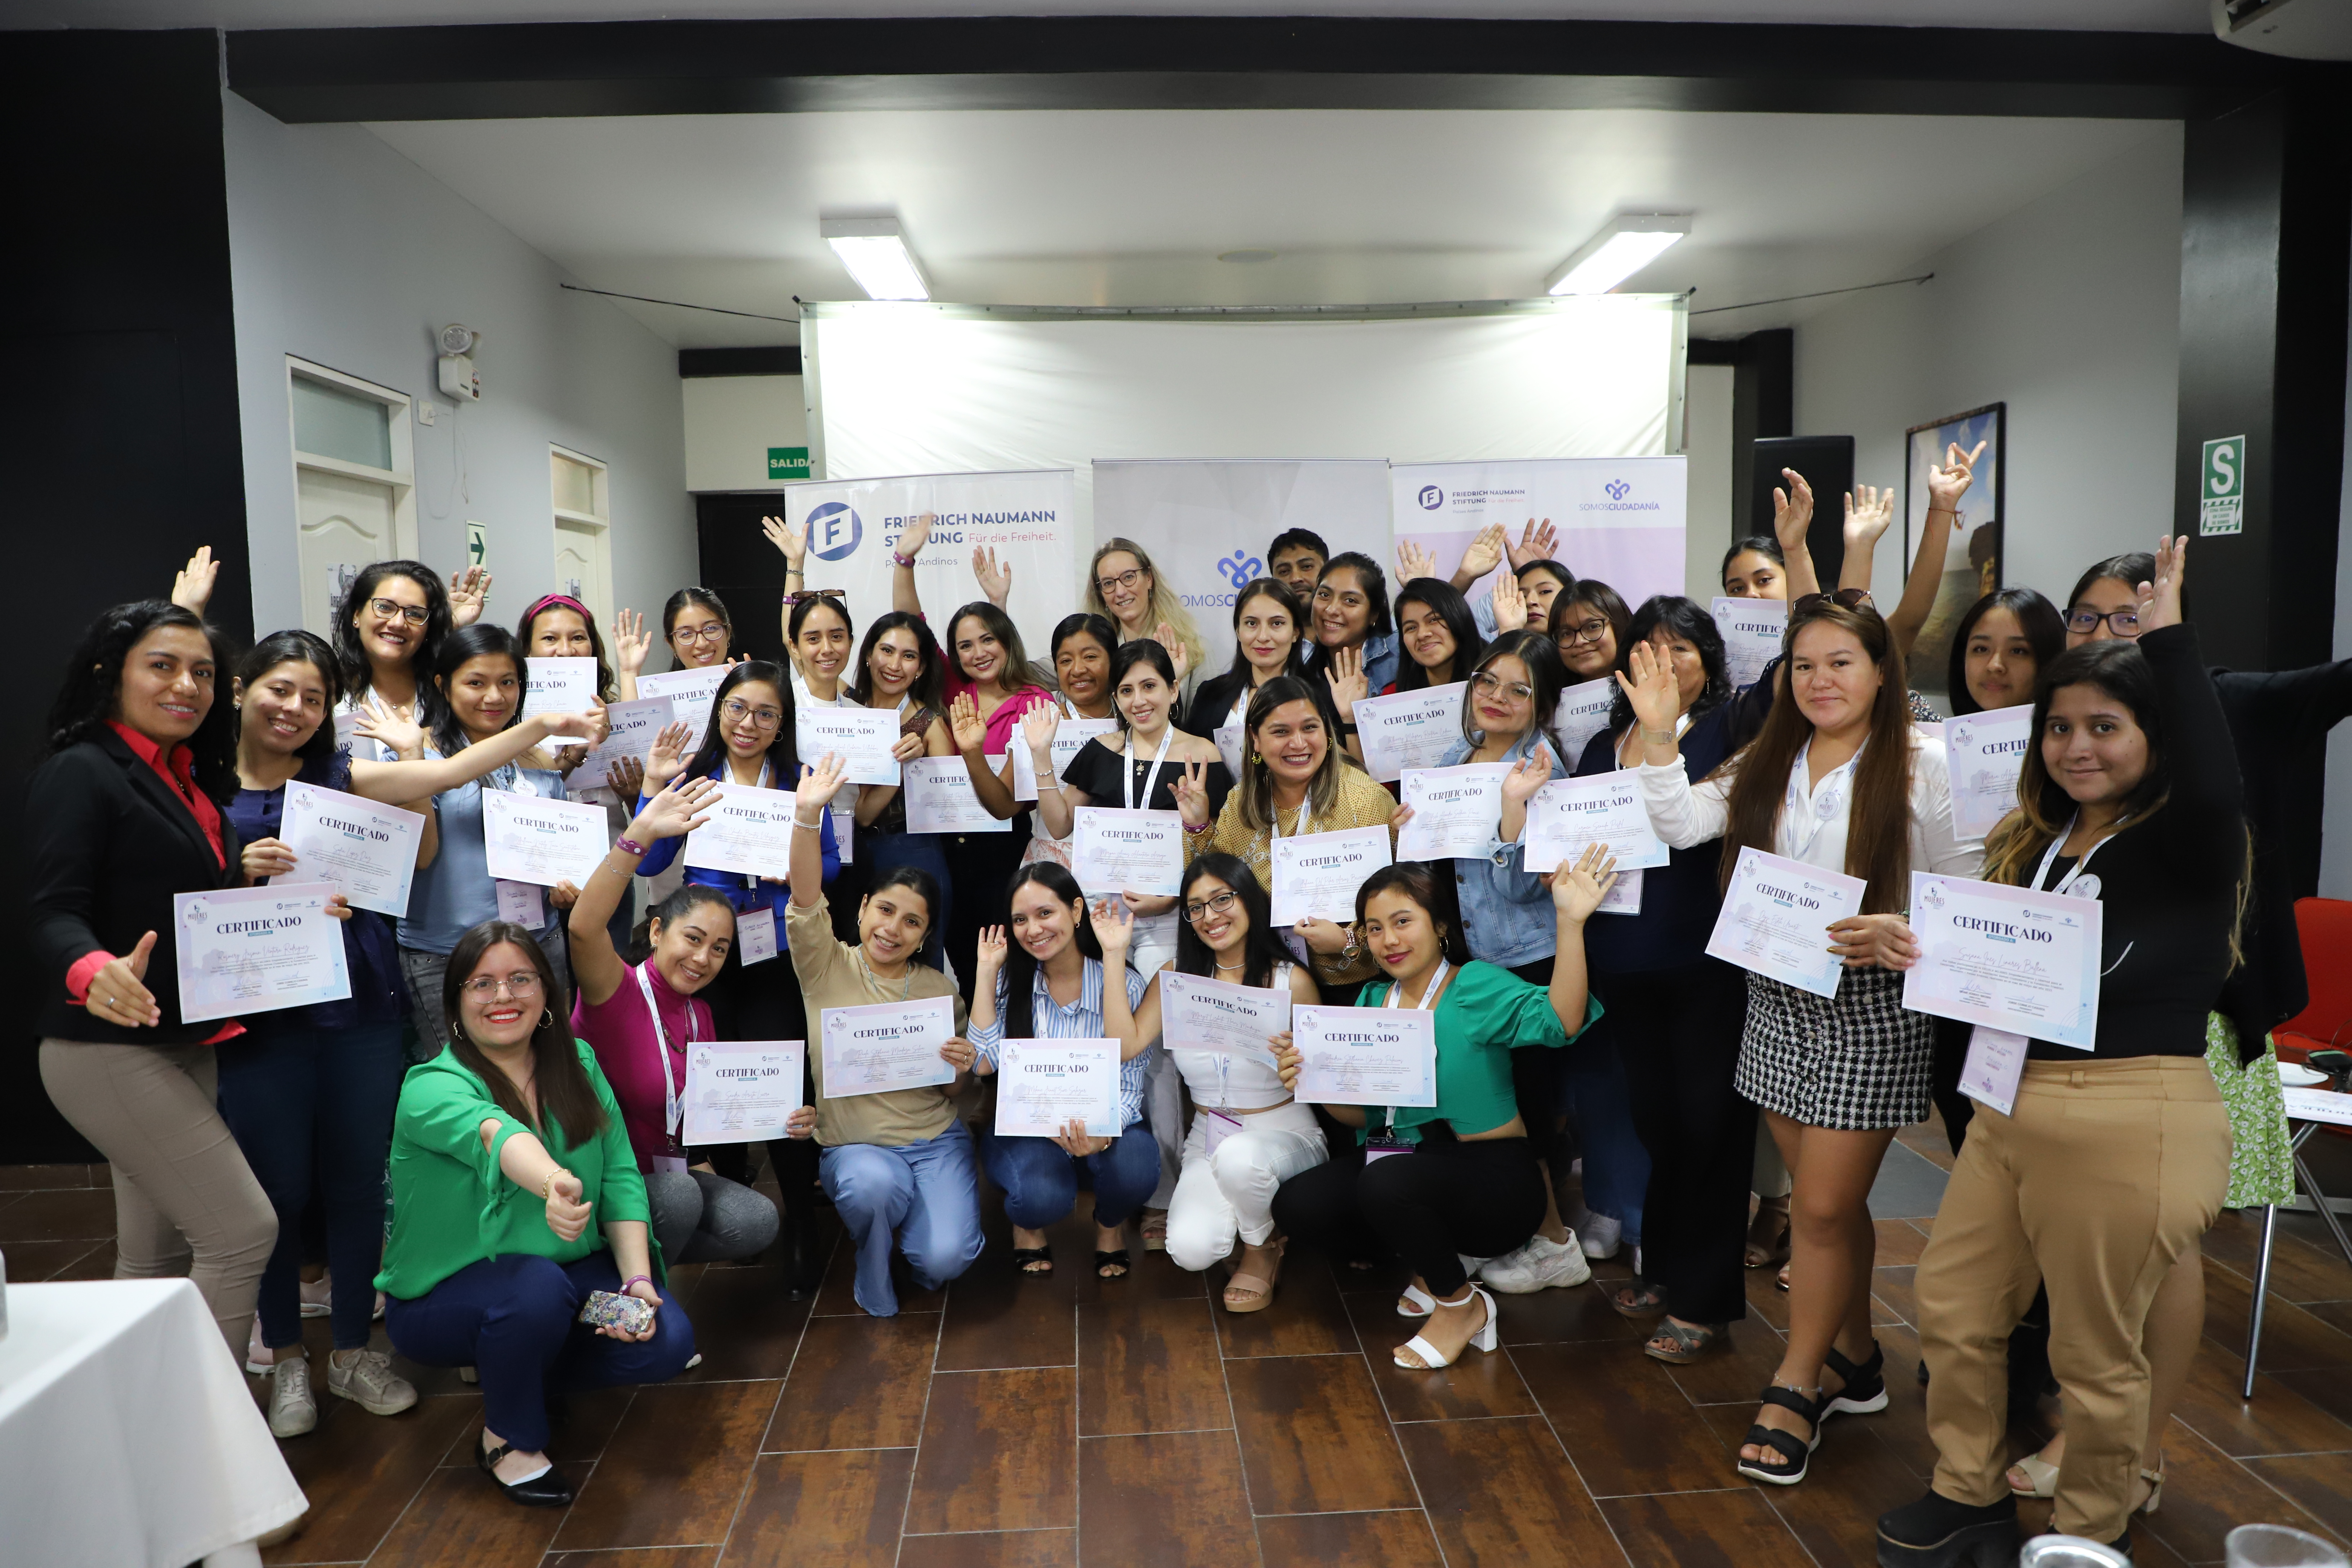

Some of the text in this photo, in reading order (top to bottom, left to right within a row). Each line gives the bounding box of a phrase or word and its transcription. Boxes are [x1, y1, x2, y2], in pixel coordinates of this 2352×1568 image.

[2211, 444, 2235, 495] S
[1579, 501, 1660, 511] SOMOSCIUDADANÍA
[972, 510, 1055, 524] NAUMANN
[969, 533, 987, 542] Für
[991, 533, 1008, 542] die
[1011, 531, 1056, 542] Freiheit.
[918, 557, 958, 567] Andinos
[1383, 708, 1446, 726] CERTIFICADO
[1955, 734, 1973, 744] MUJERES
[1429, 787, 1482, 800] CERTIFICADO
[296, 798, 313, 809] MUJERES
[1561, 796, 1632, 812] CERTIFICADO
[723, 806, 790, 823] CERTIFICADO
[319, 815, 389, 842] CERTIFICADO
[513, 816, 579, 833] CERTIFICADO
[1102, 830, 1163, 840] CERTIFICADO
[1300, 853, 1362, 867] CERTIFICADO
[1743, 865, 1756, 875] MUJERES
[1755, 882, 1820, 911] CERTIFICADO
[1924, 895, 1944, 906] MUJERES
[188, 912, 207, 921] MUJERES
[216, 916, 302, 934] CERTIFICADO
[1953, 914, 2052, 944] CERTIFICADO
[1958, 946, 1981, 964] Susana
[1191, 994, 1257, 1017] CERTIFICADO
[854, 1023, 923, 1039] CERTIFICADO
[1325, 1032, 1399, 1043] CERTIFICADO
[716, 1067, 779, 1078] CERTIFICADO
